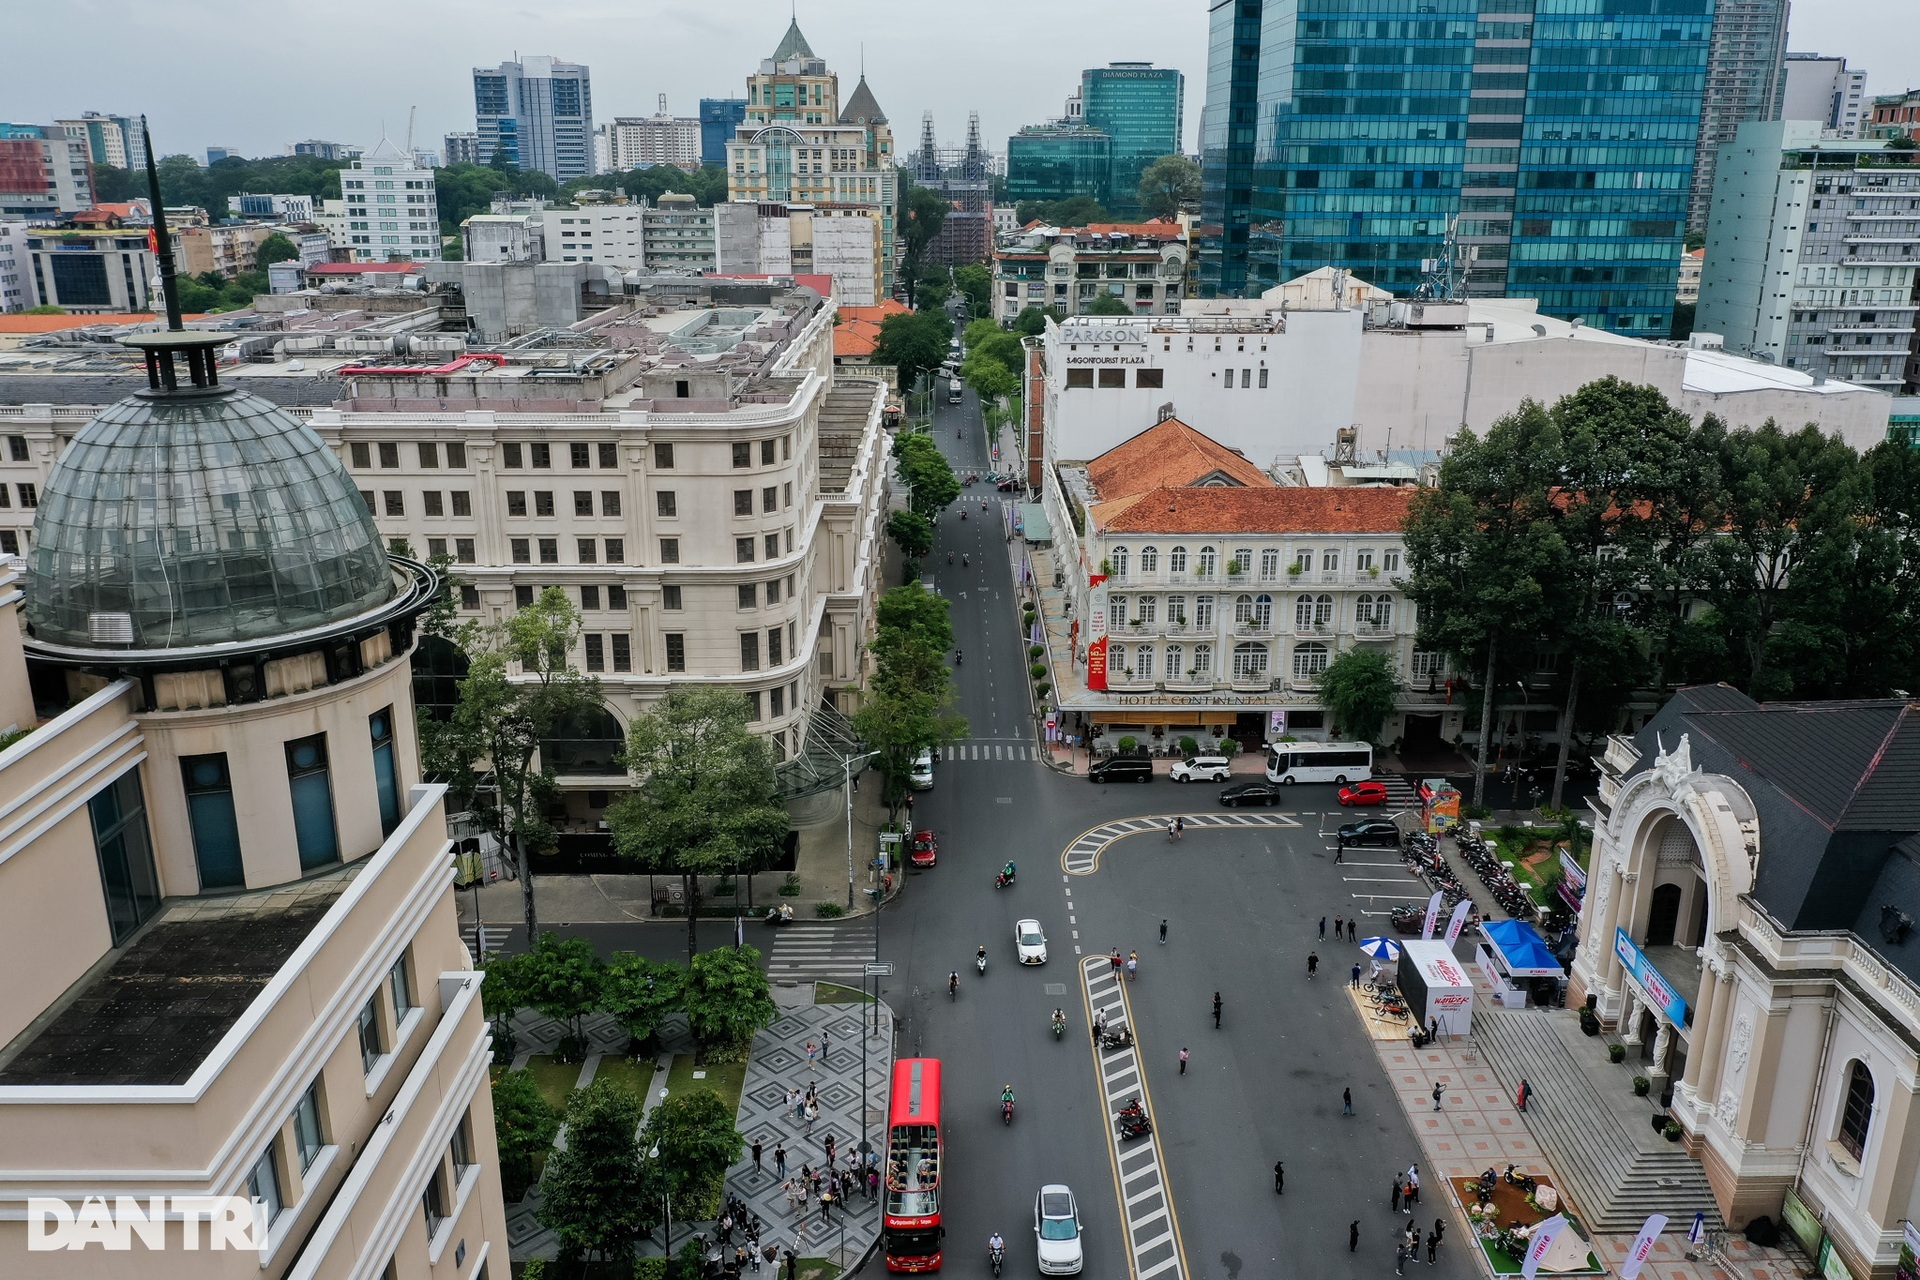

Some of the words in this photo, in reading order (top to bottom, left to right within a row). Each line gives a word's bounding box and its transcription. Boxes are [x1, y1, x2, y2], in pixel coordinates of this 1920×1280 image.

[1063, 328, 1140, 342] PARKSON
[1119, 696, 1167, 705] HOTEL
[1171, 696, 1269, 705] CONTINENTAL
[1637, 1241, 1651, 1262] YAMAHA
